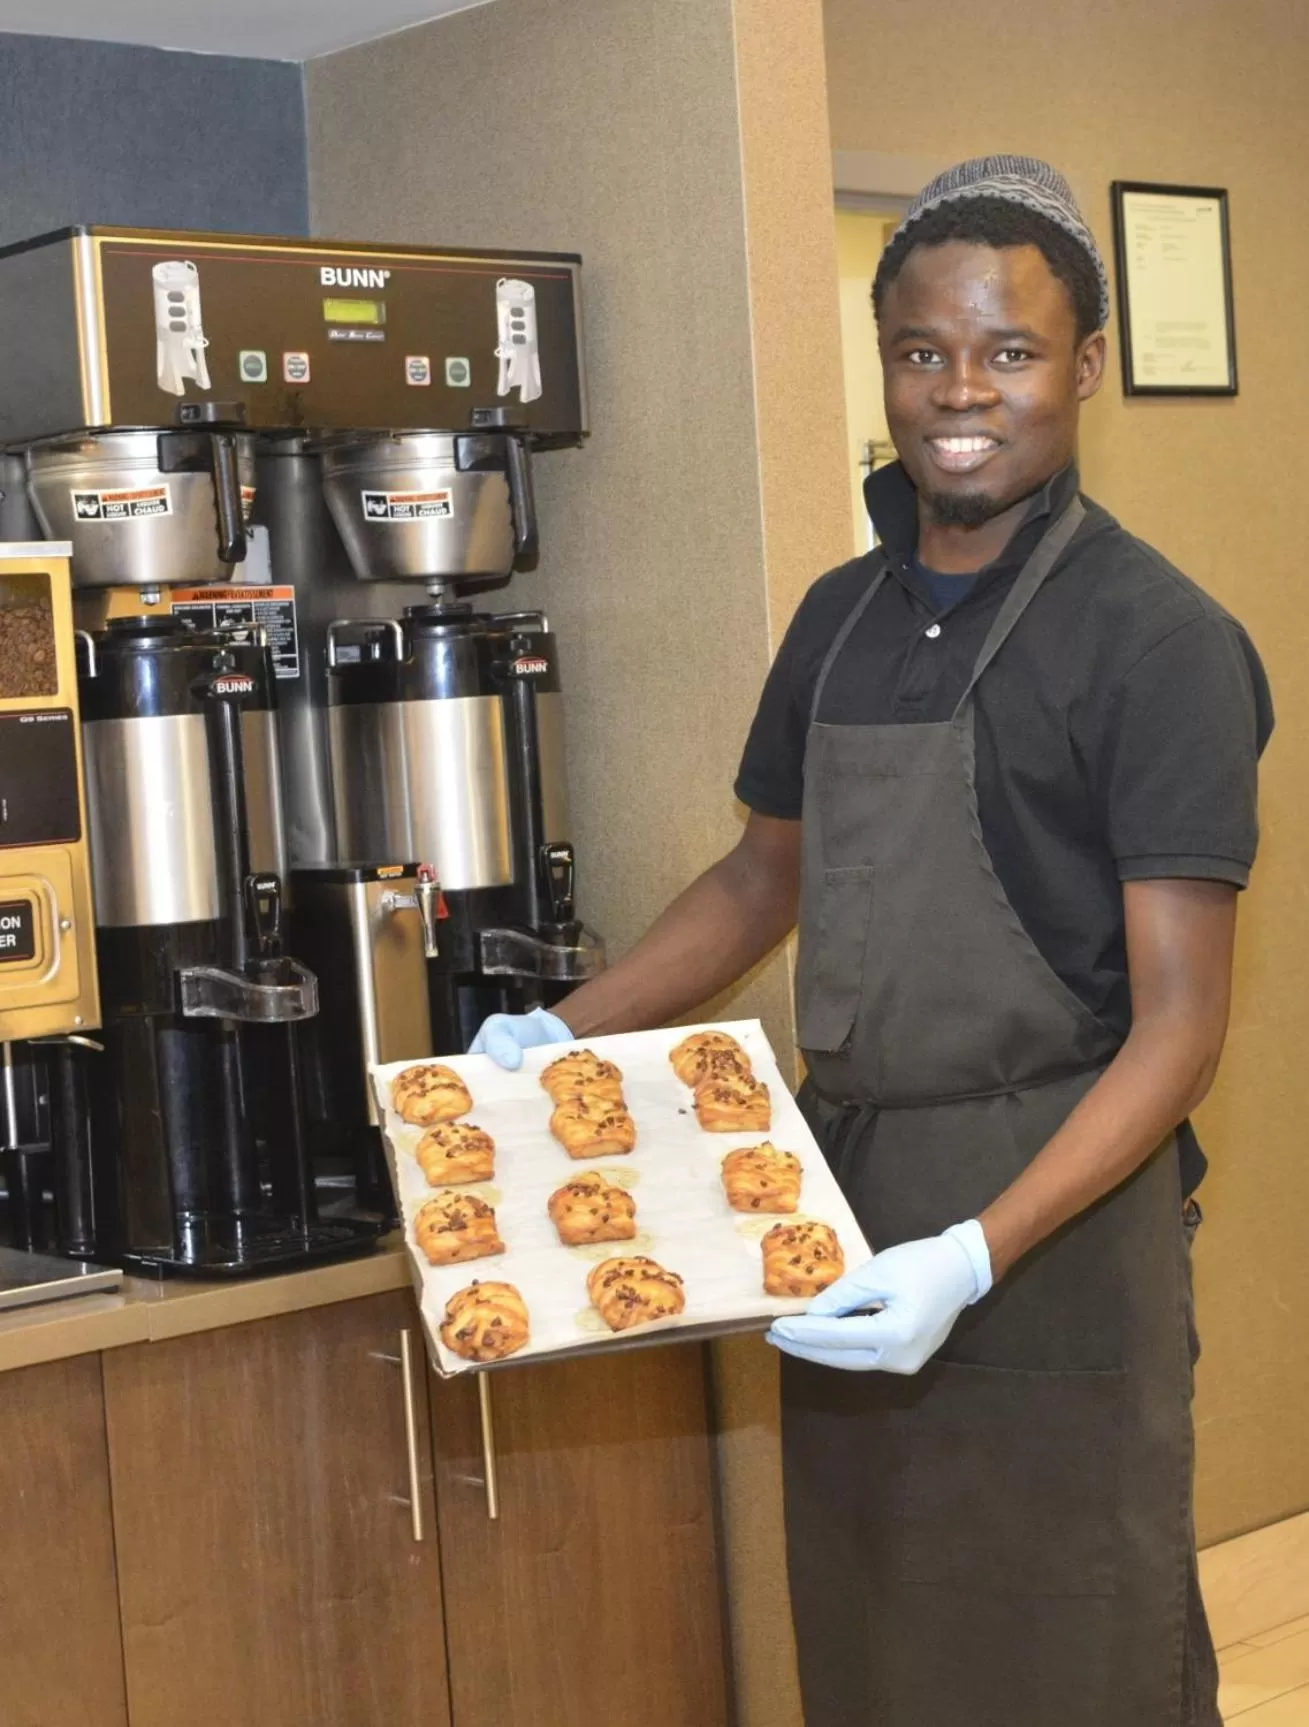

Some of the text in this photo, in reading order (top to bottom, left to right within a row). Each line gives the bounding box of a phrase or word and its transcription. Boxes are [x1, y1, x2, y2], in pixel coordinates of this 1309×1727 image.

[320, 266, 385, 288] BUNN
[515, 662, 548, 674] BUNN
[216, 681, 253, 693] BUNN
[0, 915, 21, 930] ON
